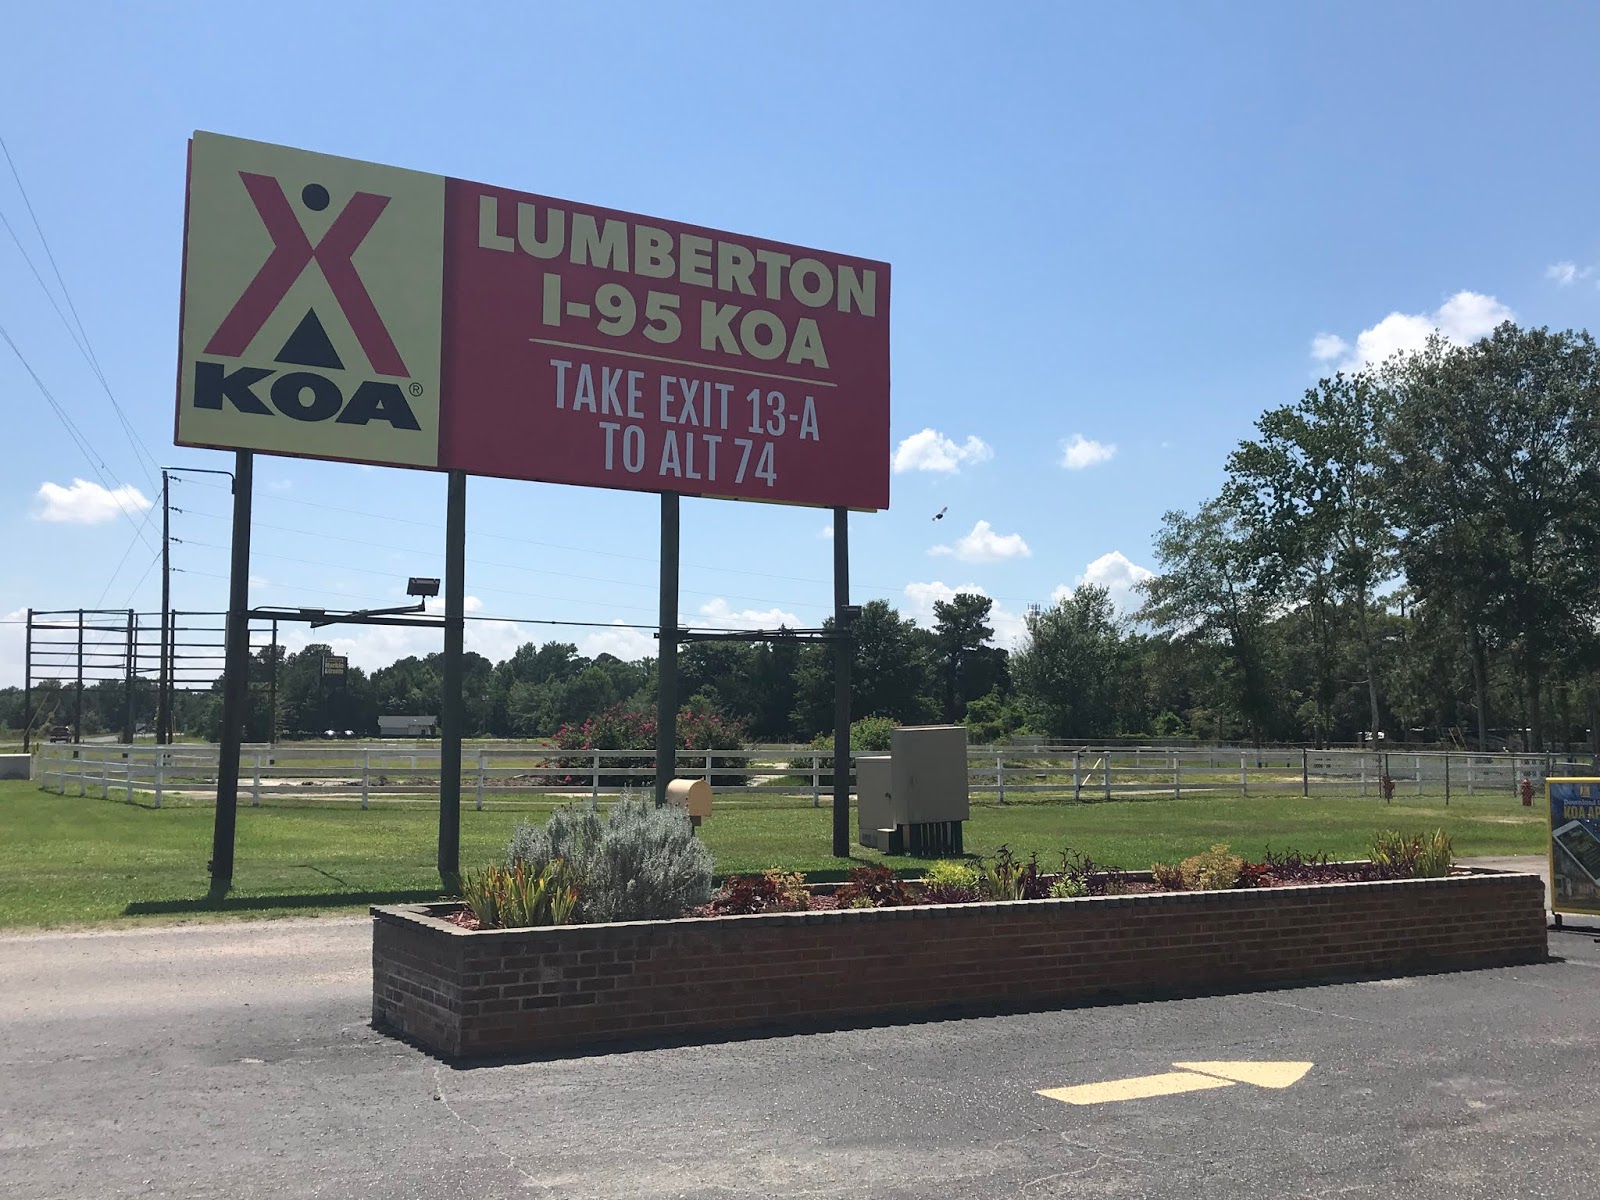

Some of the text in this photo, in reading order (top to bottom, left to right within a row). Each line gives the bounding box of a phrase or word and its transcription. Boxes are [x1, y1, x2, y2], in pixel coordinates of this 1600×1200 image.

[478, 194, 876, 317] LUMBERTON
[542, 272, 830, 369] I-95 KOA
[193, 360, 422, 432] KOA
[550, 358, 820, 441] TAKE EXIT 13-A
[598, 421, 777, 487] TO ALT 74
[1563, 805, 1586, 820] KOA
